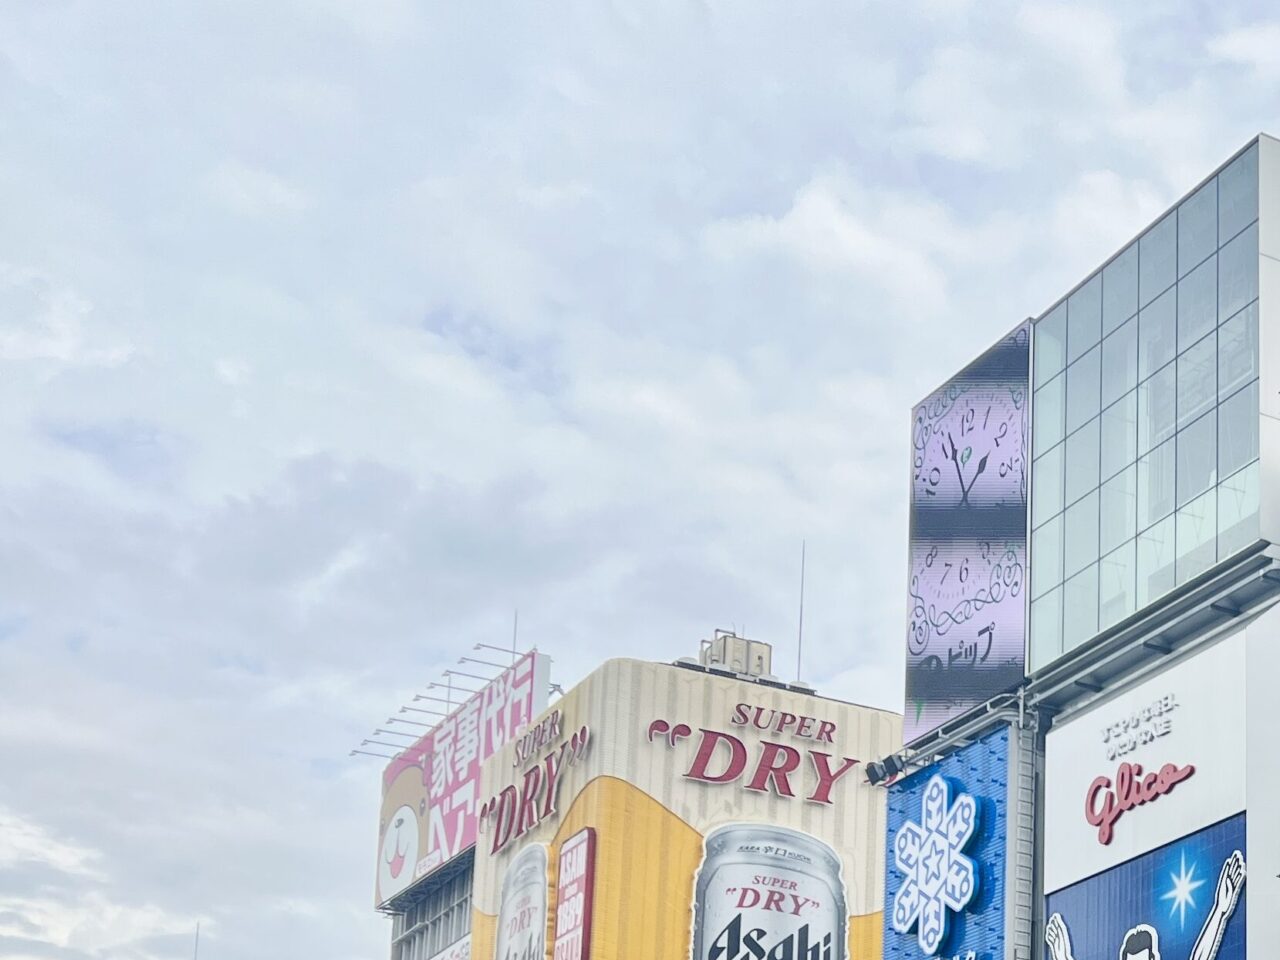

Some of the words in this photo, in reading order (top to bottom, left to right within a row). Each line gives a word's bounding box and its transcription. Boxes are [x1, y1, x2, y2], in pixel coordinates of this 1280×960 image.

[431, 655, 531, 798] 家事代行
[513, 709, 562, 767] SUPER
[731, 703, 838, 744] SUPER
[752, 875, 798, 891] SUPER
[556, 891, 584, 937] 1889
